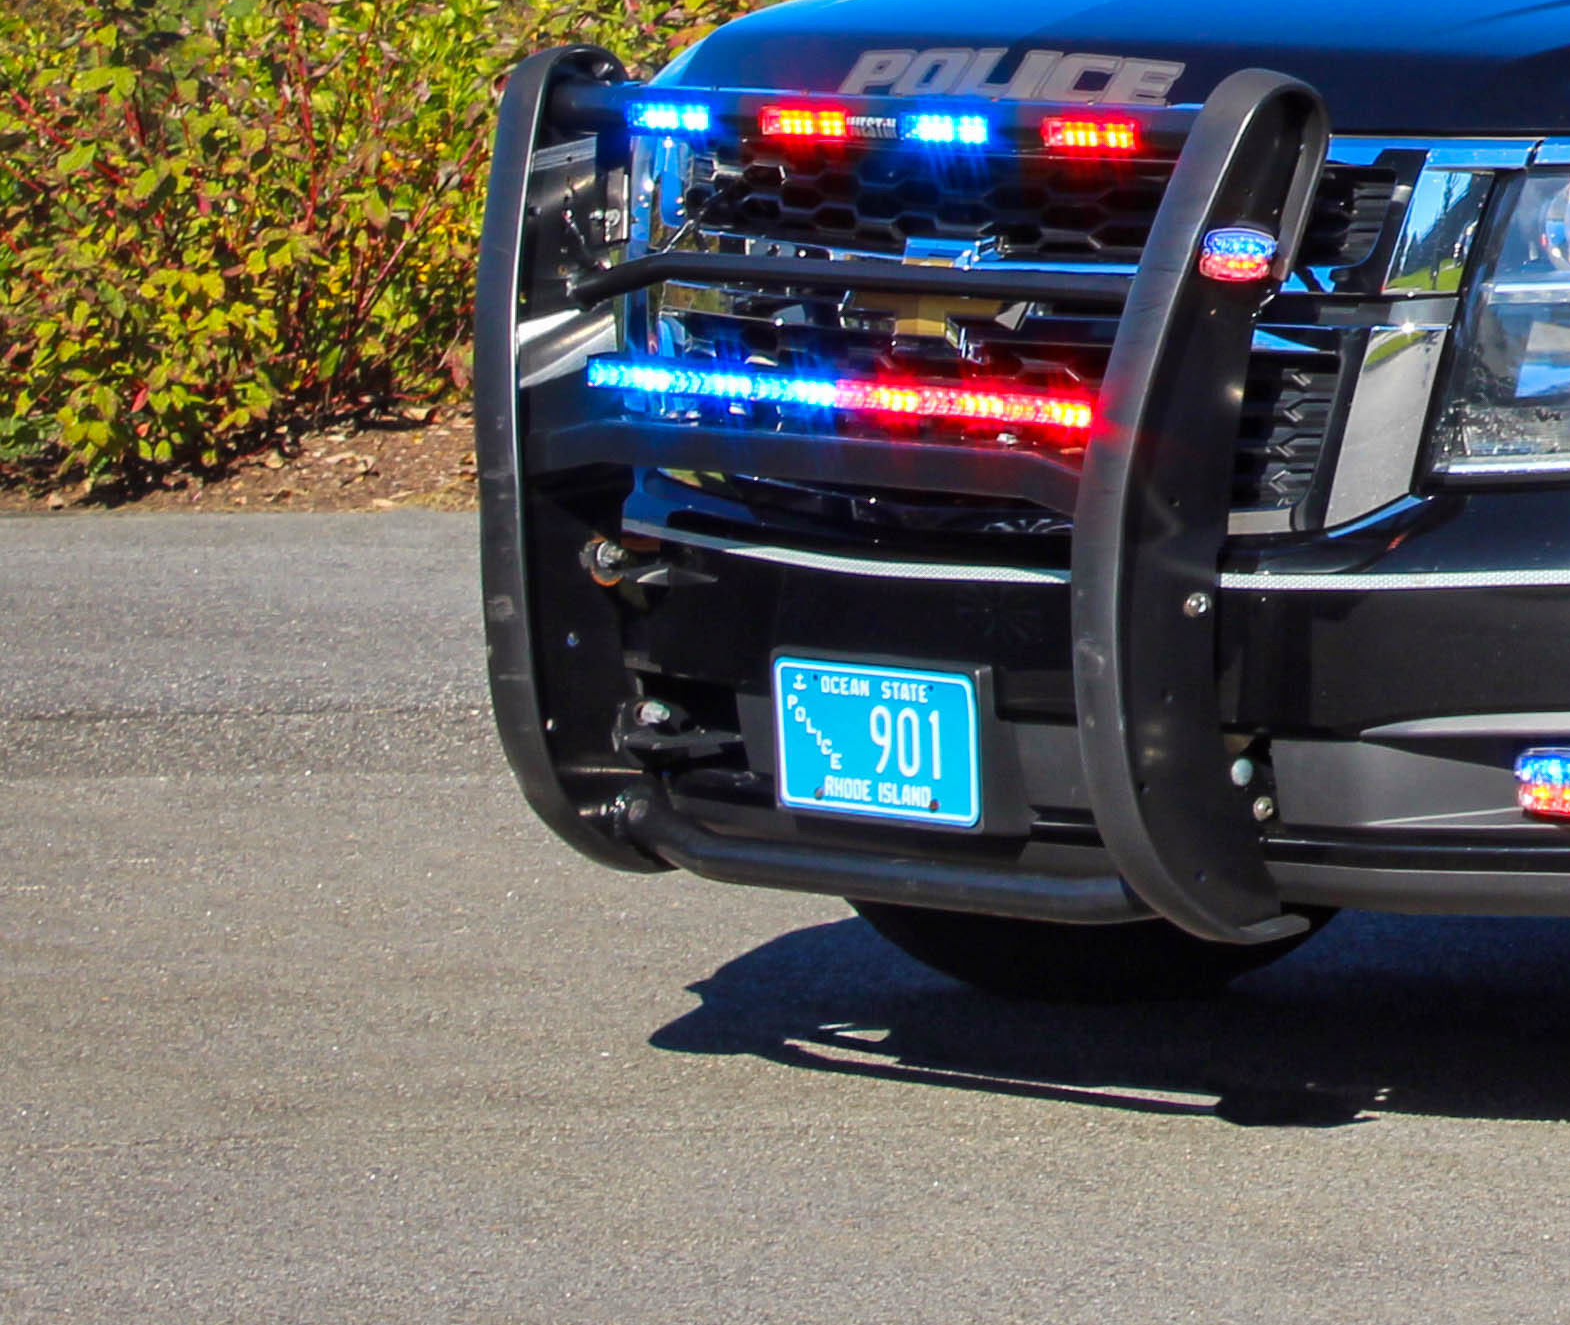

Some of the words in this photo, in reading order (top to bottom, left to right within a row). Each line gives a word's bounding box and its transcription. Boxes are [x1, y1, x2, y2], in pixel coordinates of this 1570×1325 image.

[837, 47, 1186, 108] POLICE
[820, 675, 870, 697] OCEAN
[880, 680, 928, 704] STATE
[786, 694, 843, 770] POLICE
[869, 704, 942, 781] 901
[823, 774, 872, 802] RHODE
[877, 781, 932, 808] ISLAND
